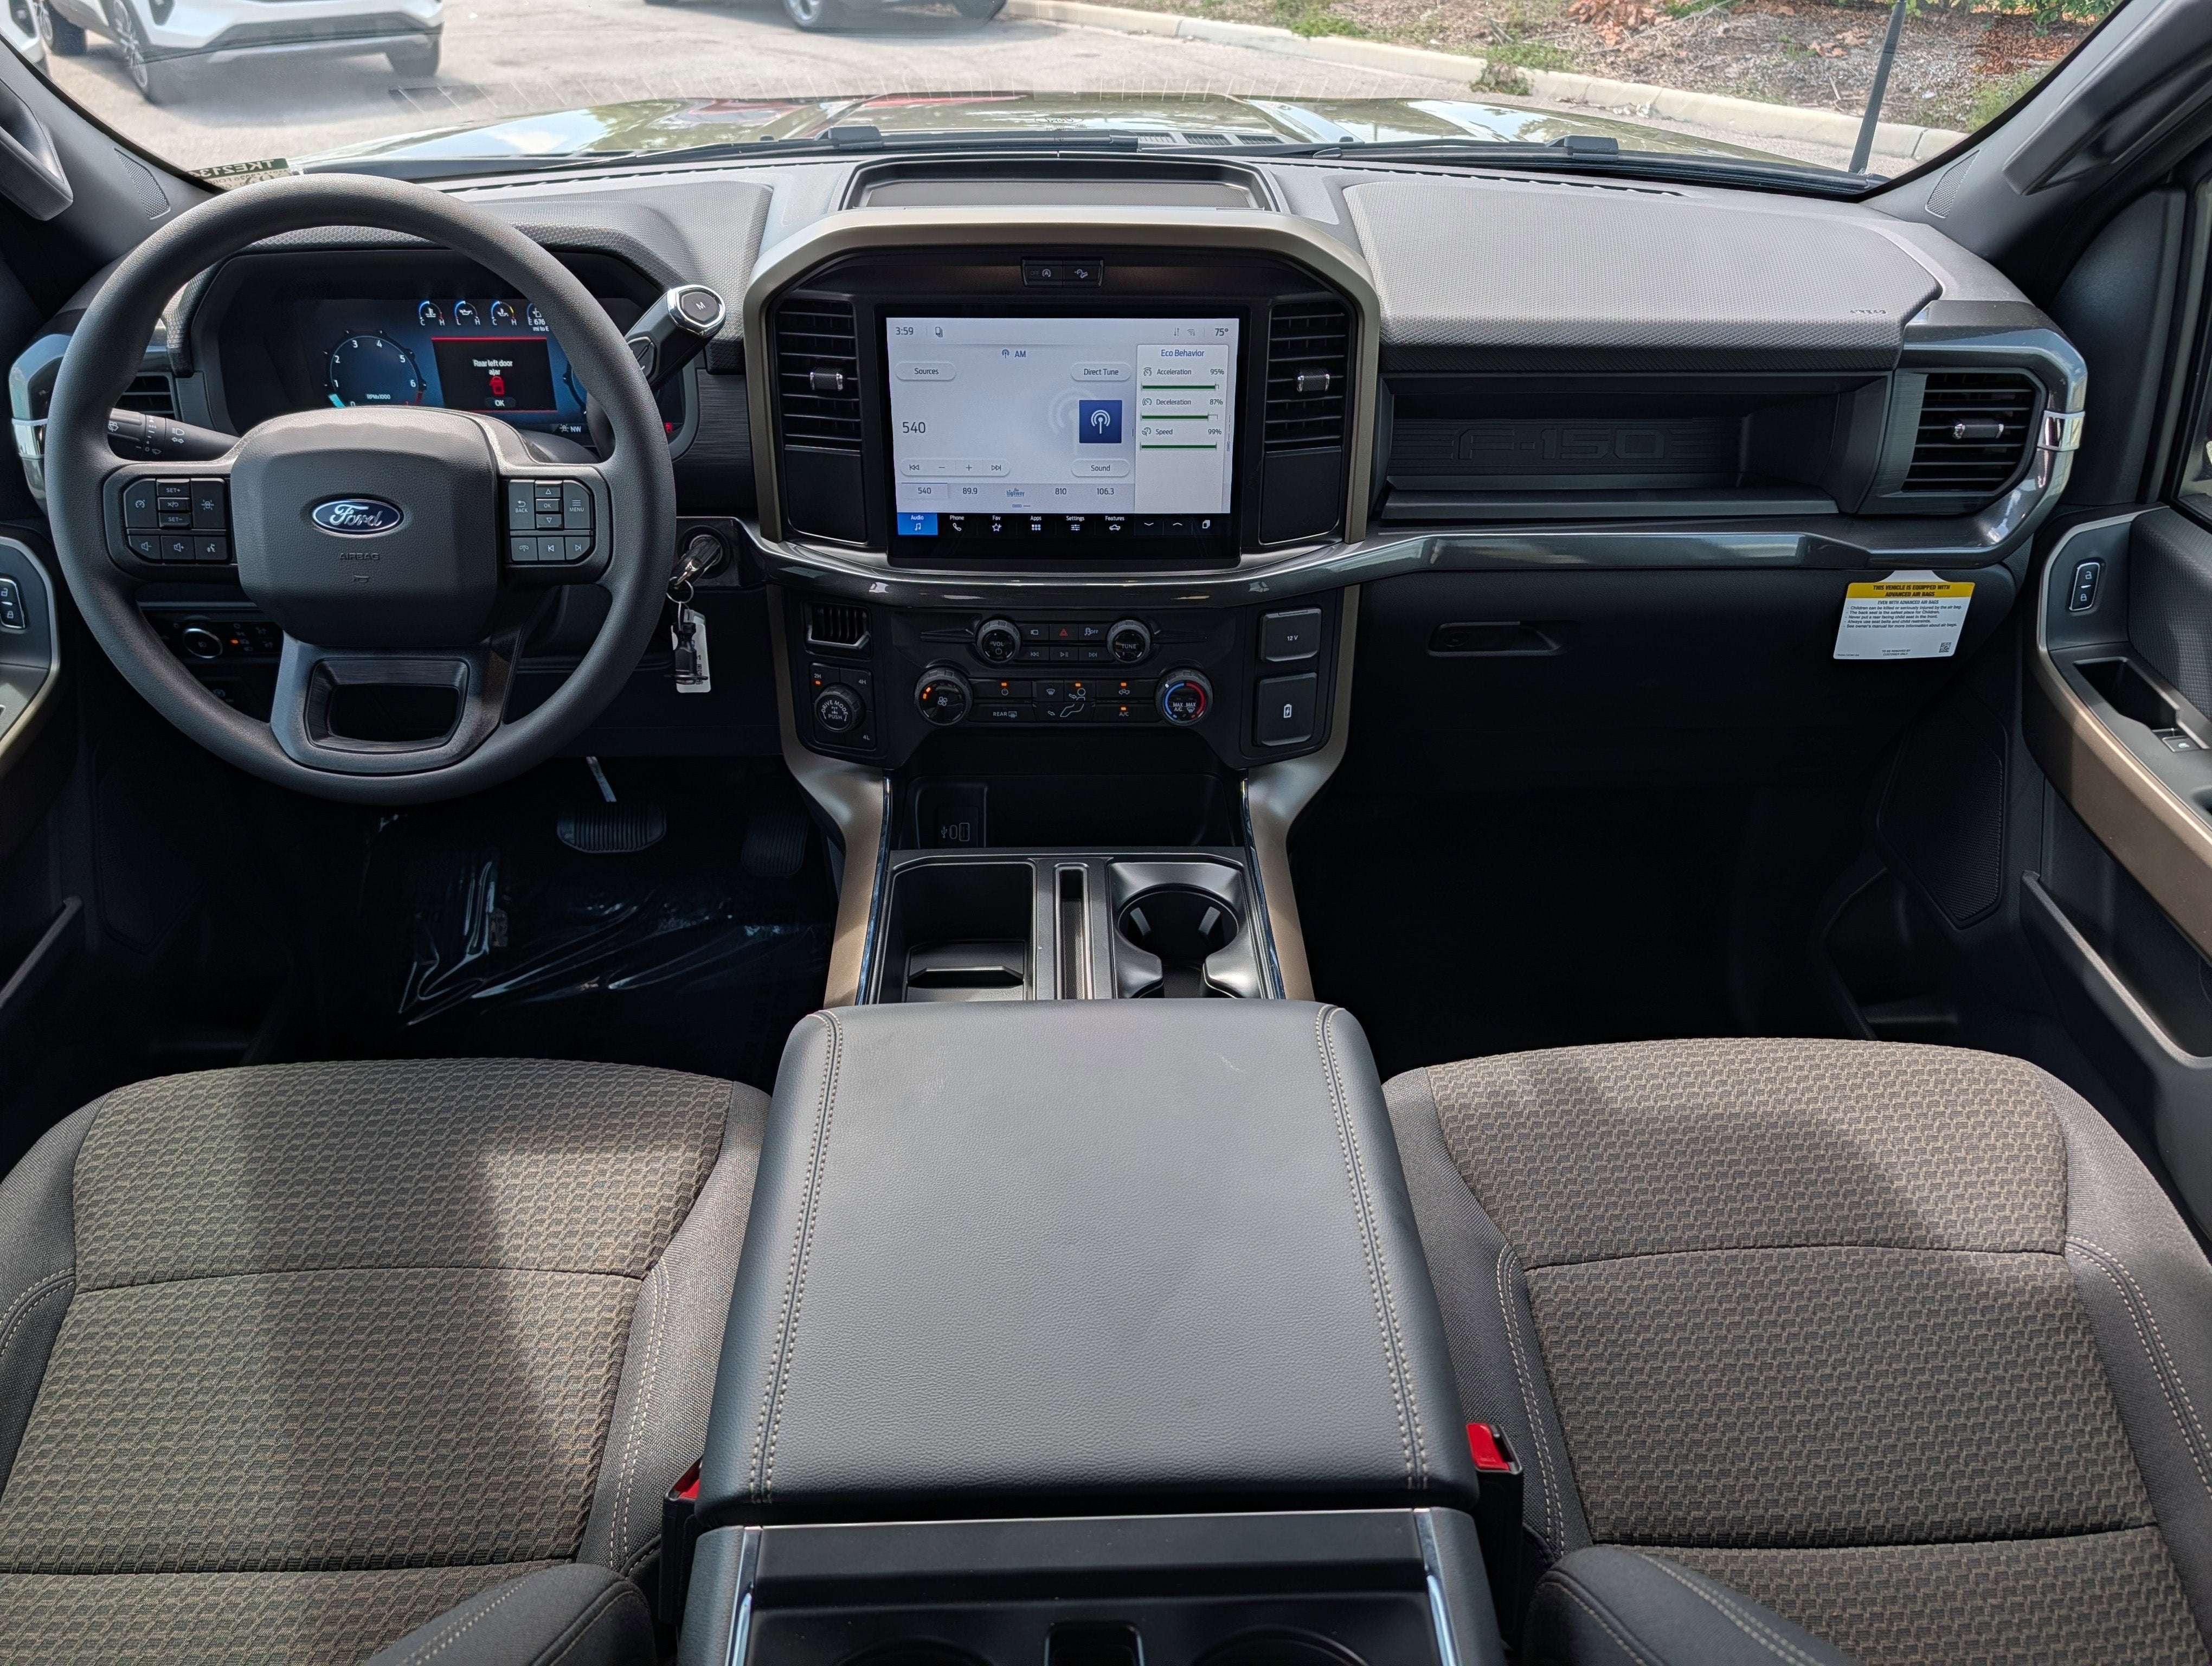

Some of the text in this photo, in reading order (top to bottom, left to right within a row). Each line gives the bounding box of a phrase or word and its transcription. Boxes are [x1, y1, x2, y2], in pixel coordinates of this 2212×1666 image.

[696, 302, 706, 310] M
[895, 326, 914, 336] 3:59
[352, 340, 358, 348] 3
[377, 339, 383, 348] 4
[1161, 349, 1205, 357] Eco Behavior
[335, 355, 340, 363] 2
[399, 355, 406, 363] 5
[914, 367, 939, 375] Sources
[333, 379, 339, 387] 1
[410, 379, 416, 387] 6
[902, 421, 926, 433] 540
[1458, 428, 1664, 459] F-150
[329, 504, 382, 526] Ford
[339, 553, 380, 561] AIRBAG
[821, 700, 848, 715] DRIVE MODE
